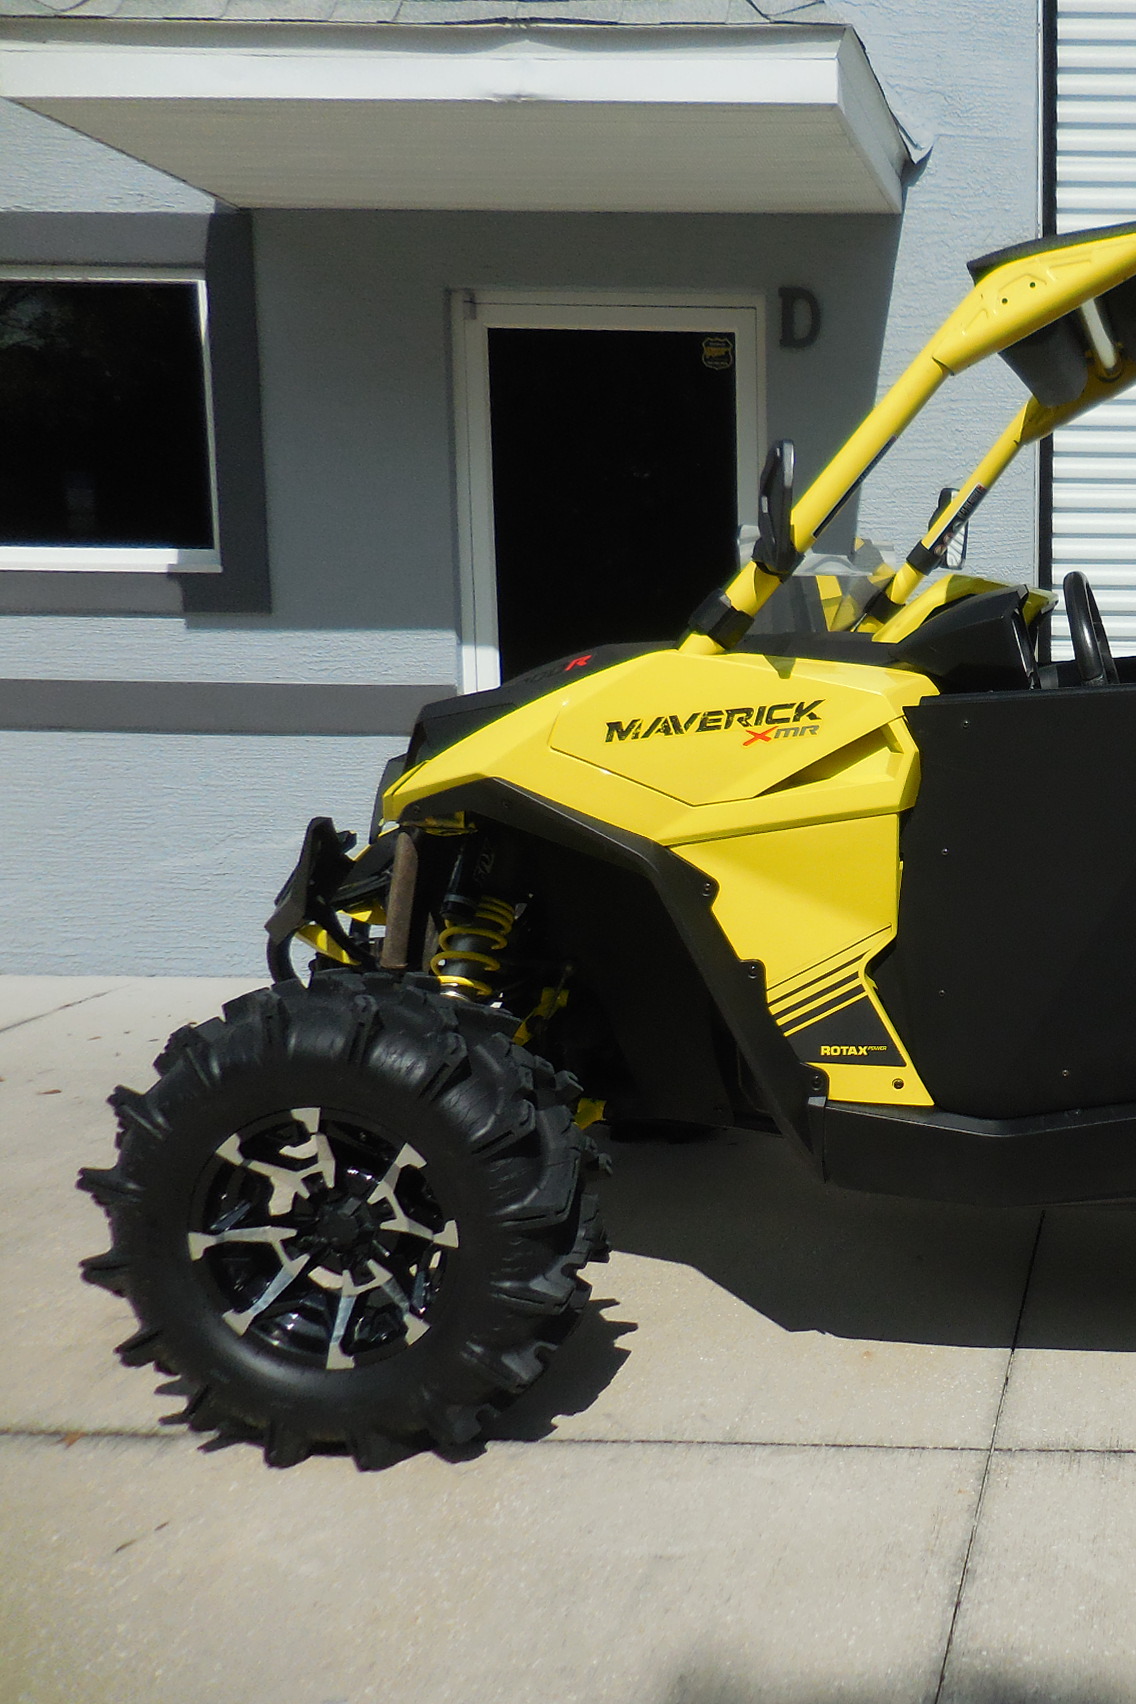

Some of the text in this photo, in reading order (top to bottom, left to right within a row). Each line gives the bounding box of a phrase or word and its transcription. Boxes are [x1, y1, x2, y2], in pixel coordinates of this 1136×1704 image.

[778, 286, 821, 348] D
[604, 698, 827, 743] MAVERICK
[820, 1045, 867, 1056] ROTAX
